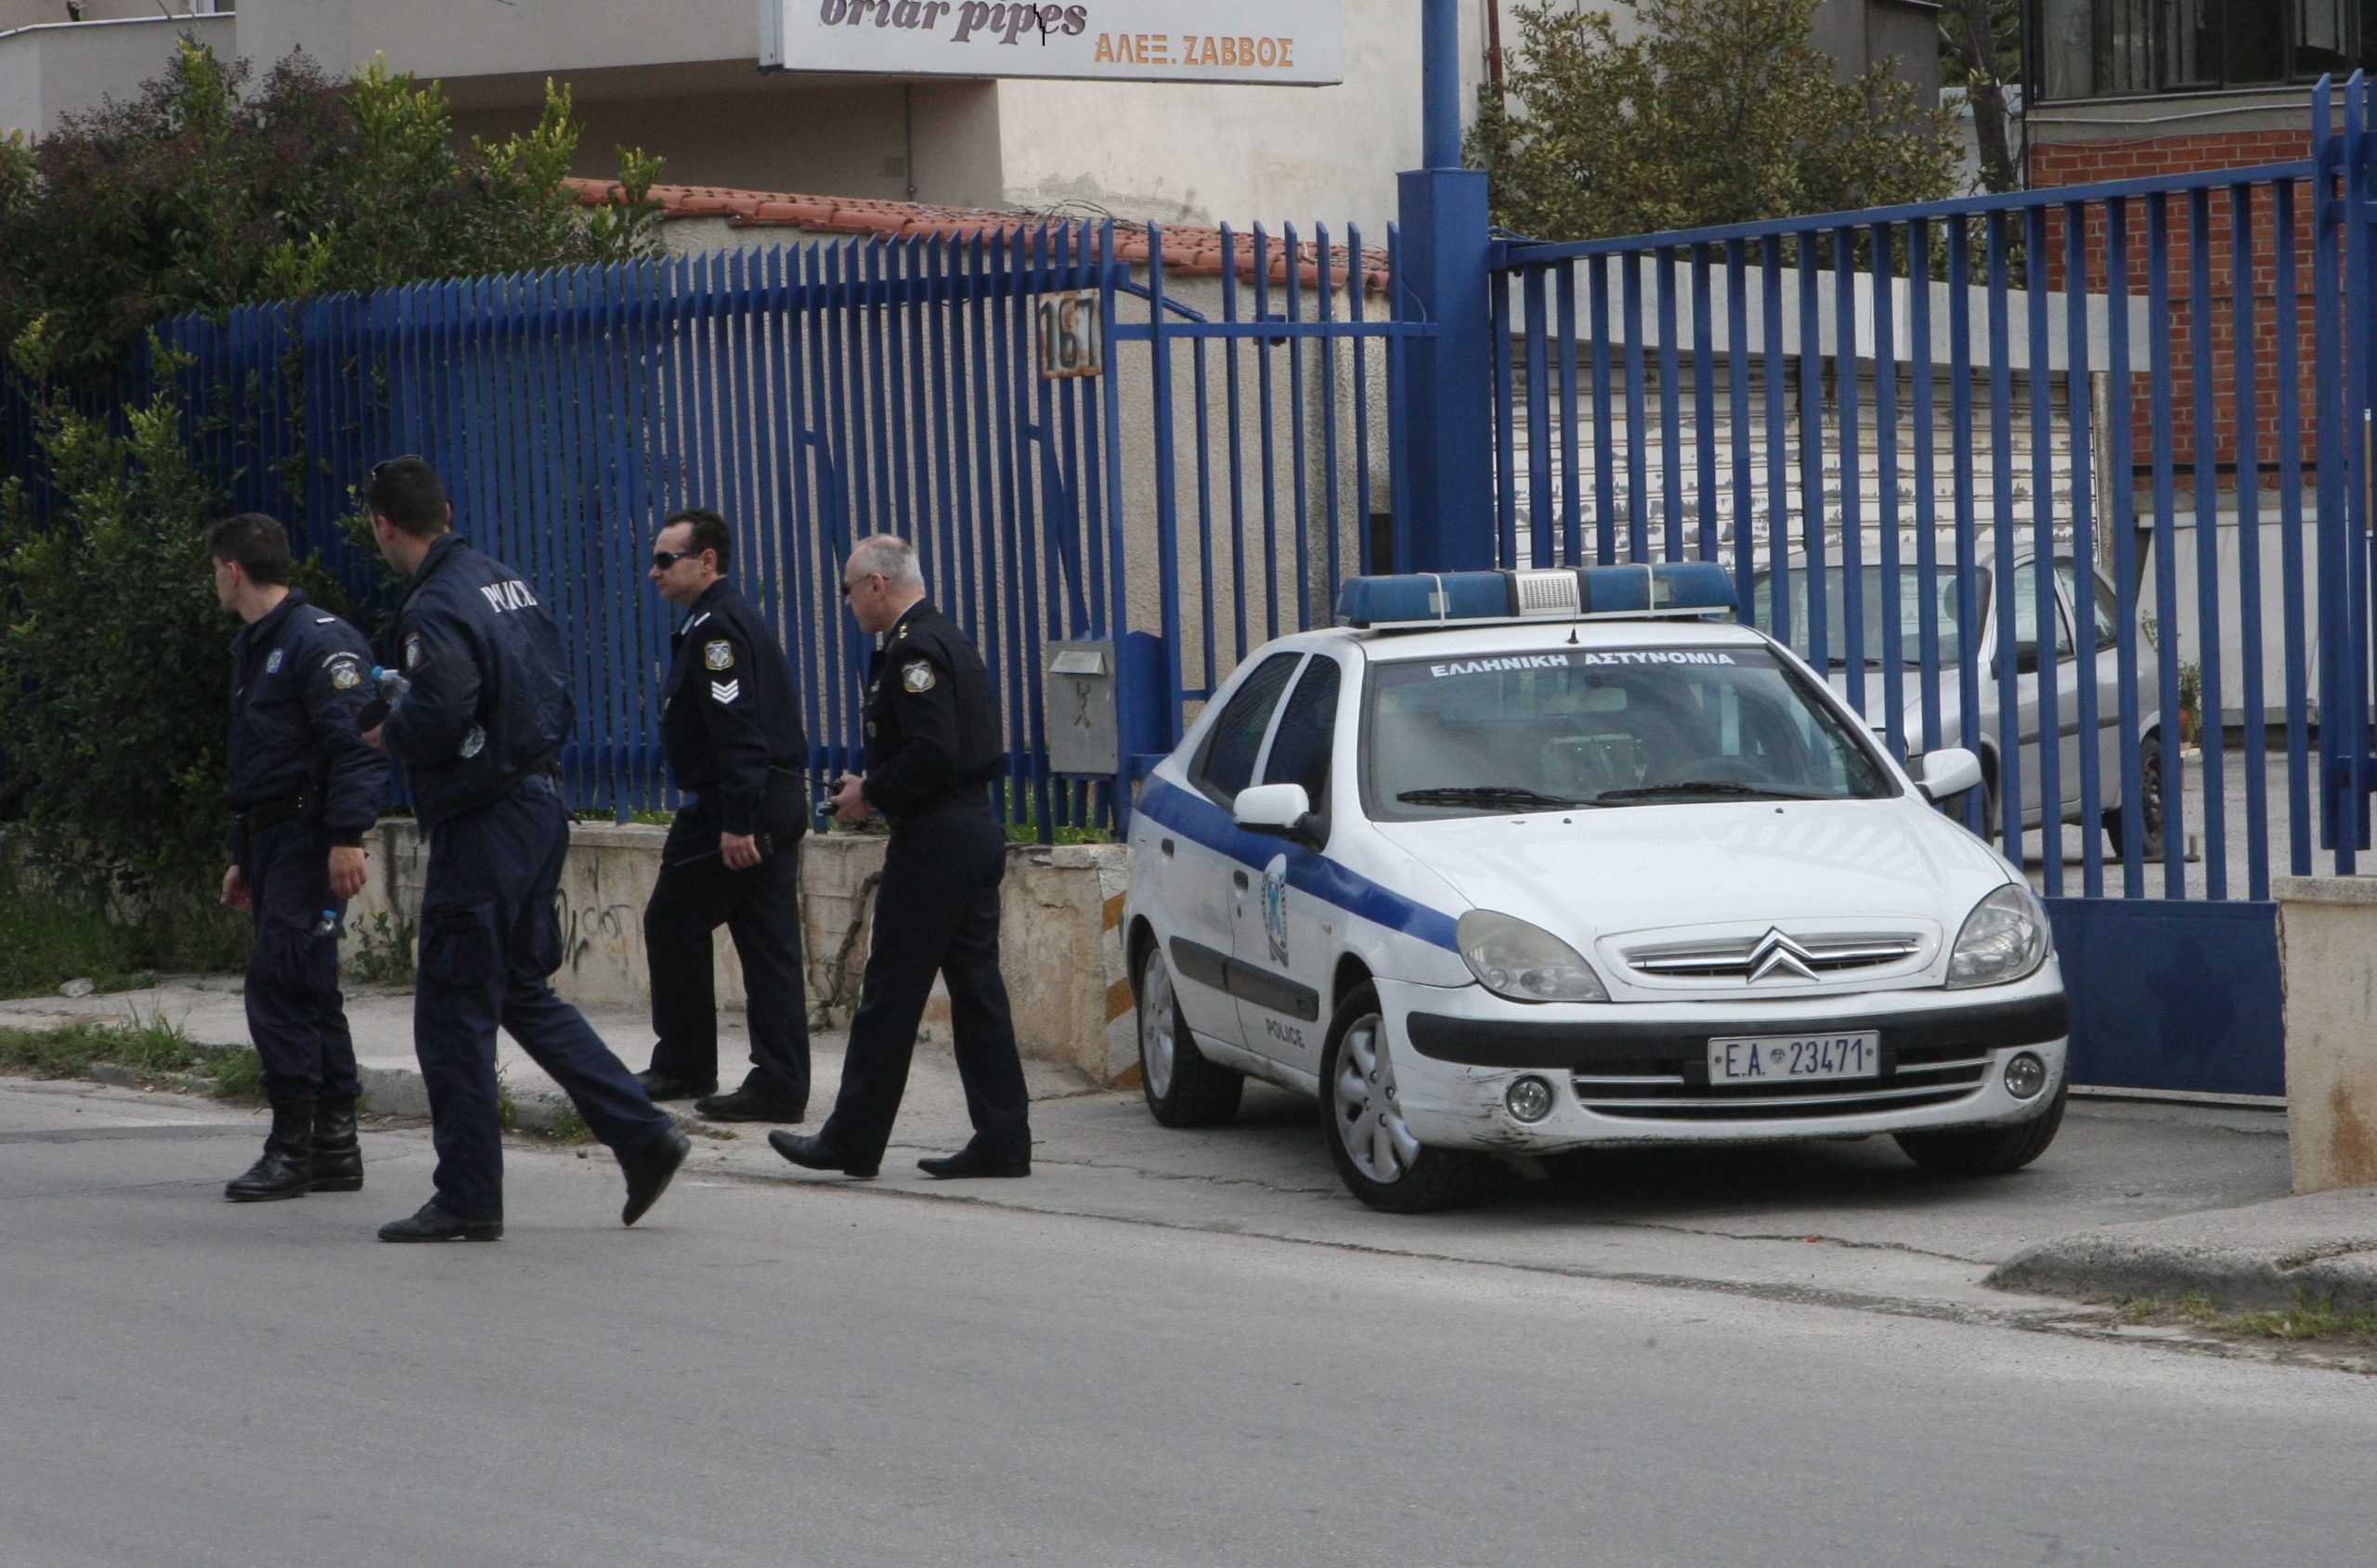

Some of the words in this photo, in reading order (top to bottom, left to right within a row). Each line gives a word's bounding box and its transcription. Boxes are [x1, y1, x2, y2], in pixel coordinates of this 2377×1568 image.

[951, 0, 1088, 45] pipes
[1095, 32, 1177, 65] ΑΛΕΞ.
[1182, 35, 1294, 68] ΖΑΒΒΟΣ
[1430, 654, 1569, 678] ΕΛΛΗΝΙΚΗ
[1585, 652, 1736, 666] ΑΣΤΥΝΟΜΙΑ
[1266, 1017, 1305, 1050] POLICE
[1788, 1038, 1864, 1075] 23471
